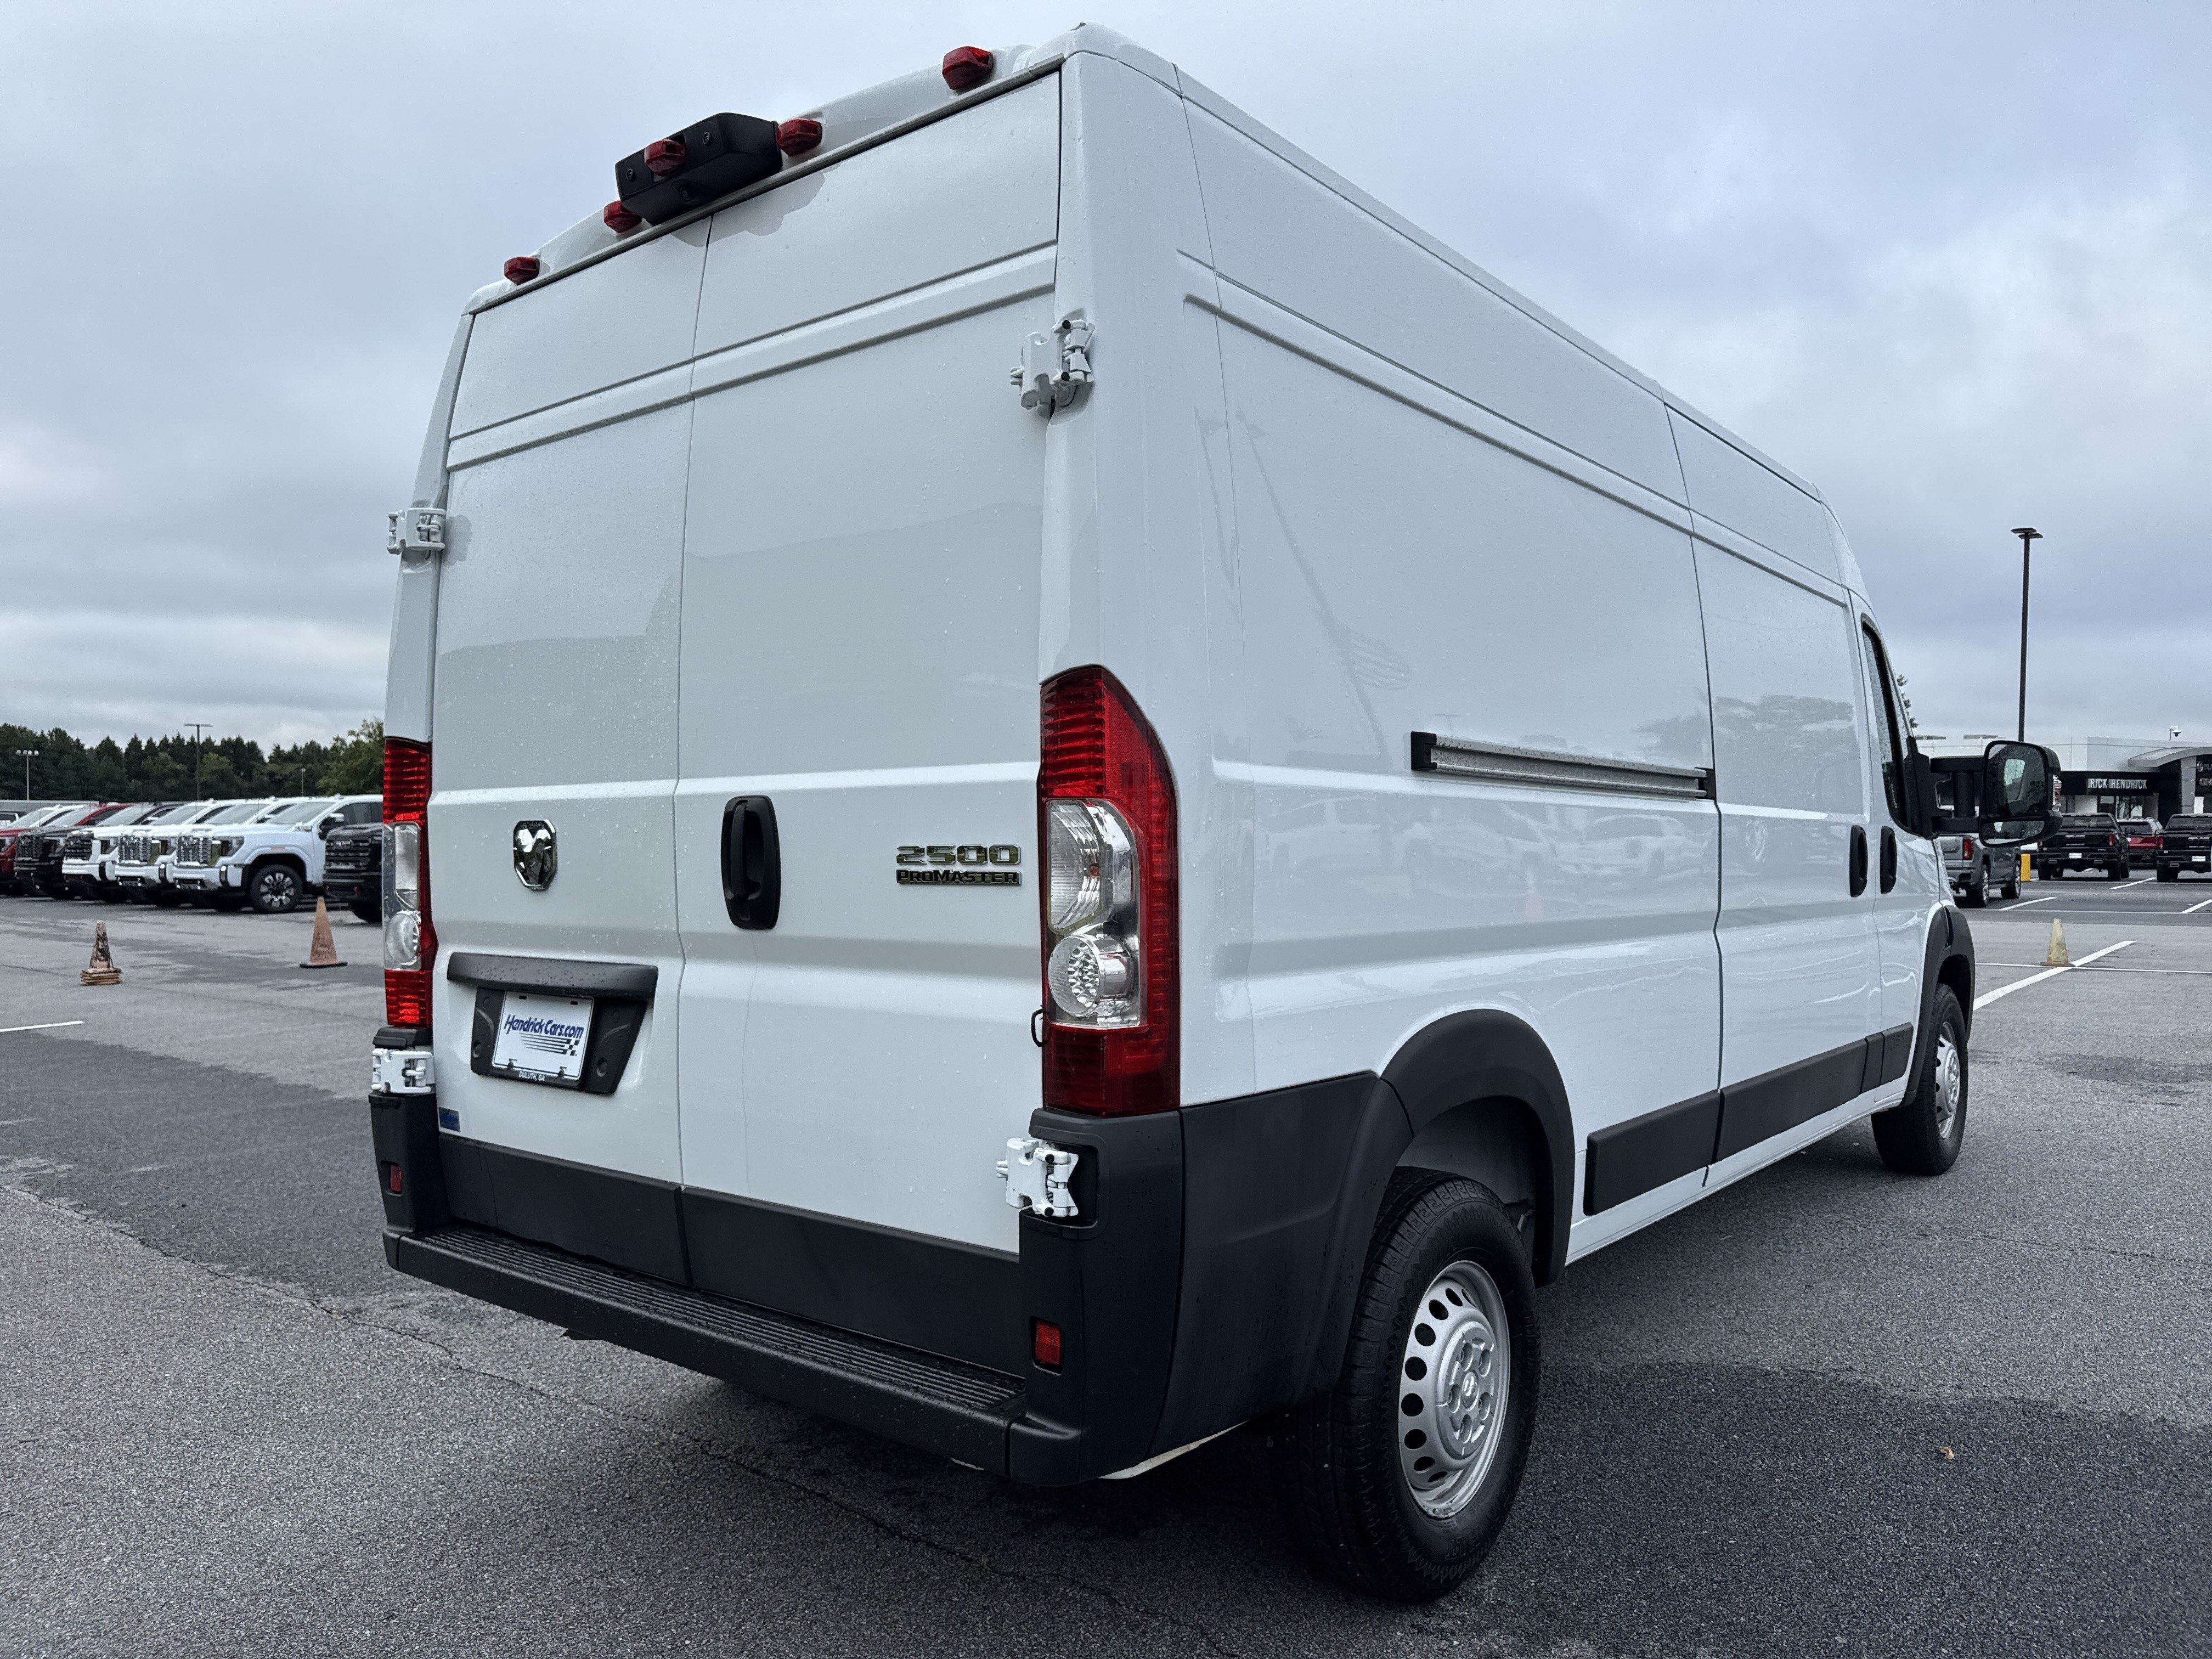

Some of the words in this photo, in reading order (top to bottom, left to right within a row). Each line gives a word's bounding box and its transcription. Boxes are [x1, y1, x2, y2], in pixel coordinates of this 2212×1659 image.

[2087, 778, 2107, 789] RICK
[2108, 778, 2147, 789] HENDRICK
[896, 845, 1021, 865] 2500
[518, 1071, 537, 1080] DULUTH,
